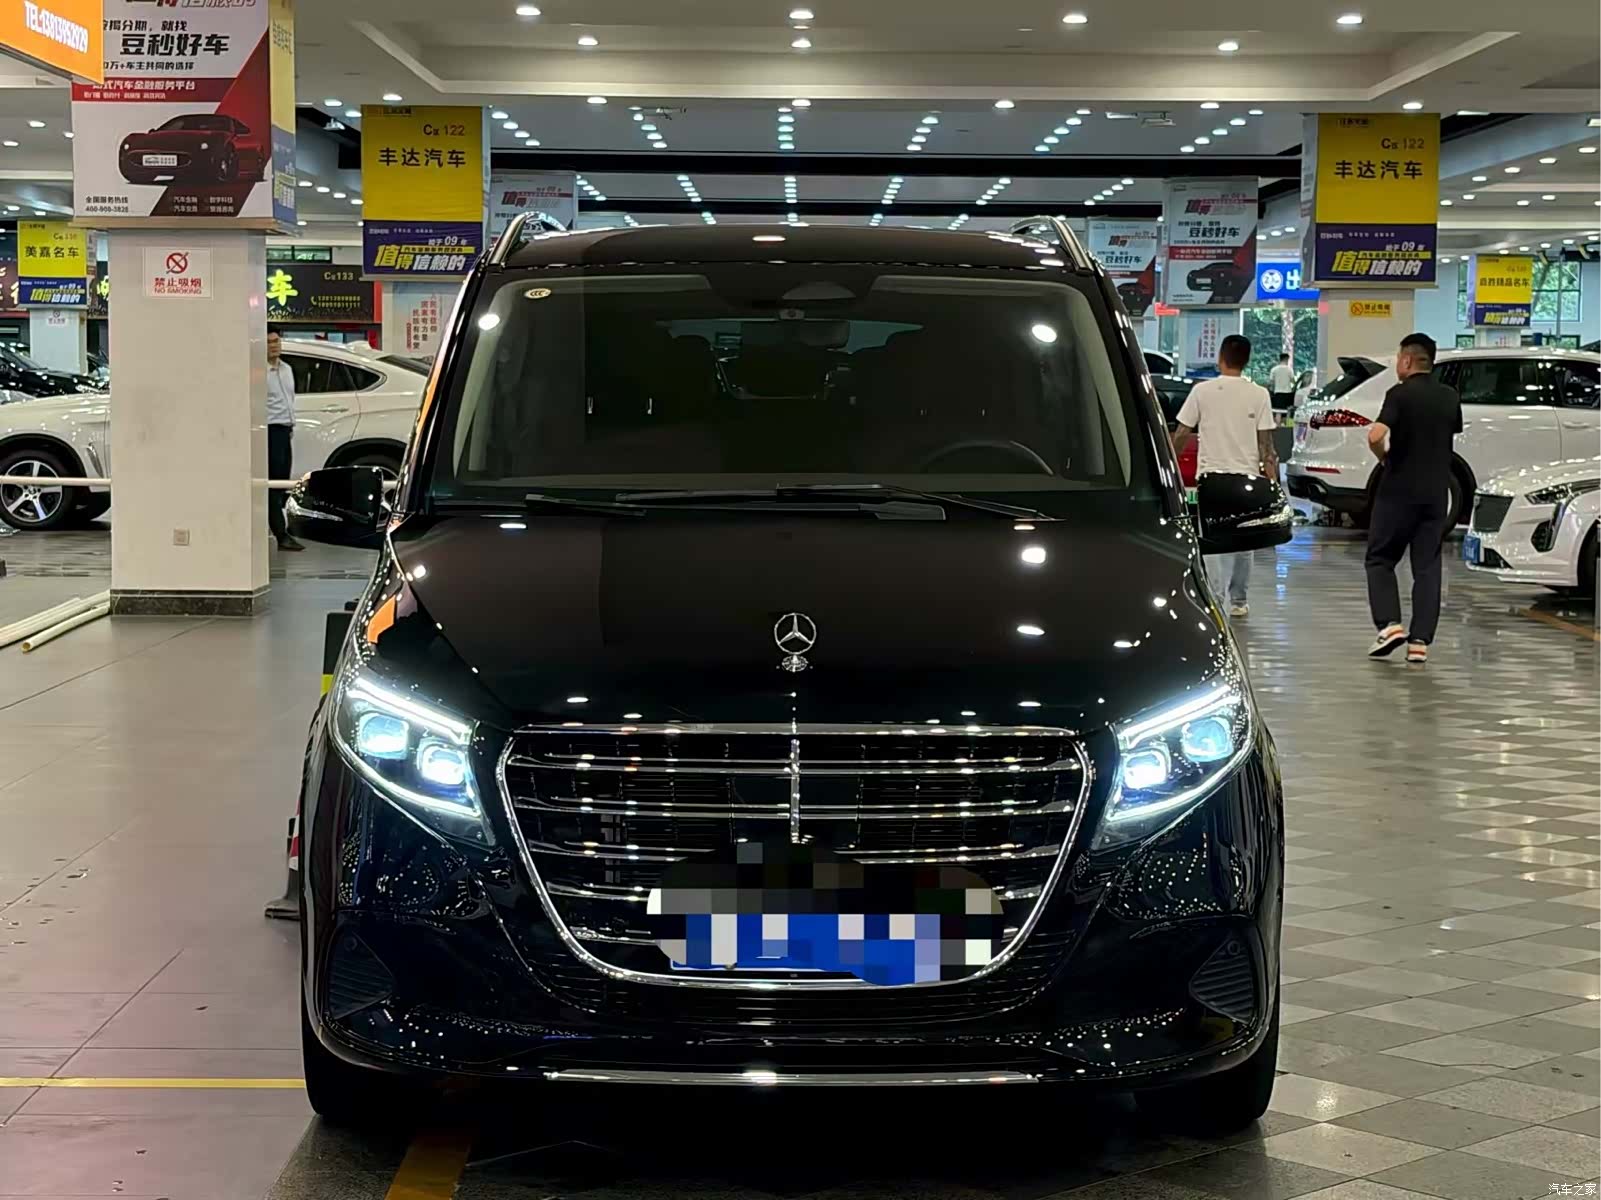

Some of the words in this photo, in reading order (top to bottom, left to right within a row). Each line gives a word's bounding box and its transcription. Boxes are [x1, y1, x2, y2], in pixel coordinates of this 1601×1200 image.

[120, 33, 230, 56] 豆秒好车
[378, 147, 466, 168] 丰达汽车
[1334, 160, 1423, 179] 丰达汽车
[25, 246, 79, 258] 美嘉名车
[374, 244, 466, 271] 值得信赖的
[1331, 251, 1423, 275] 值得信赖的
[155, 277, 202, 287] 禁止吸烟
